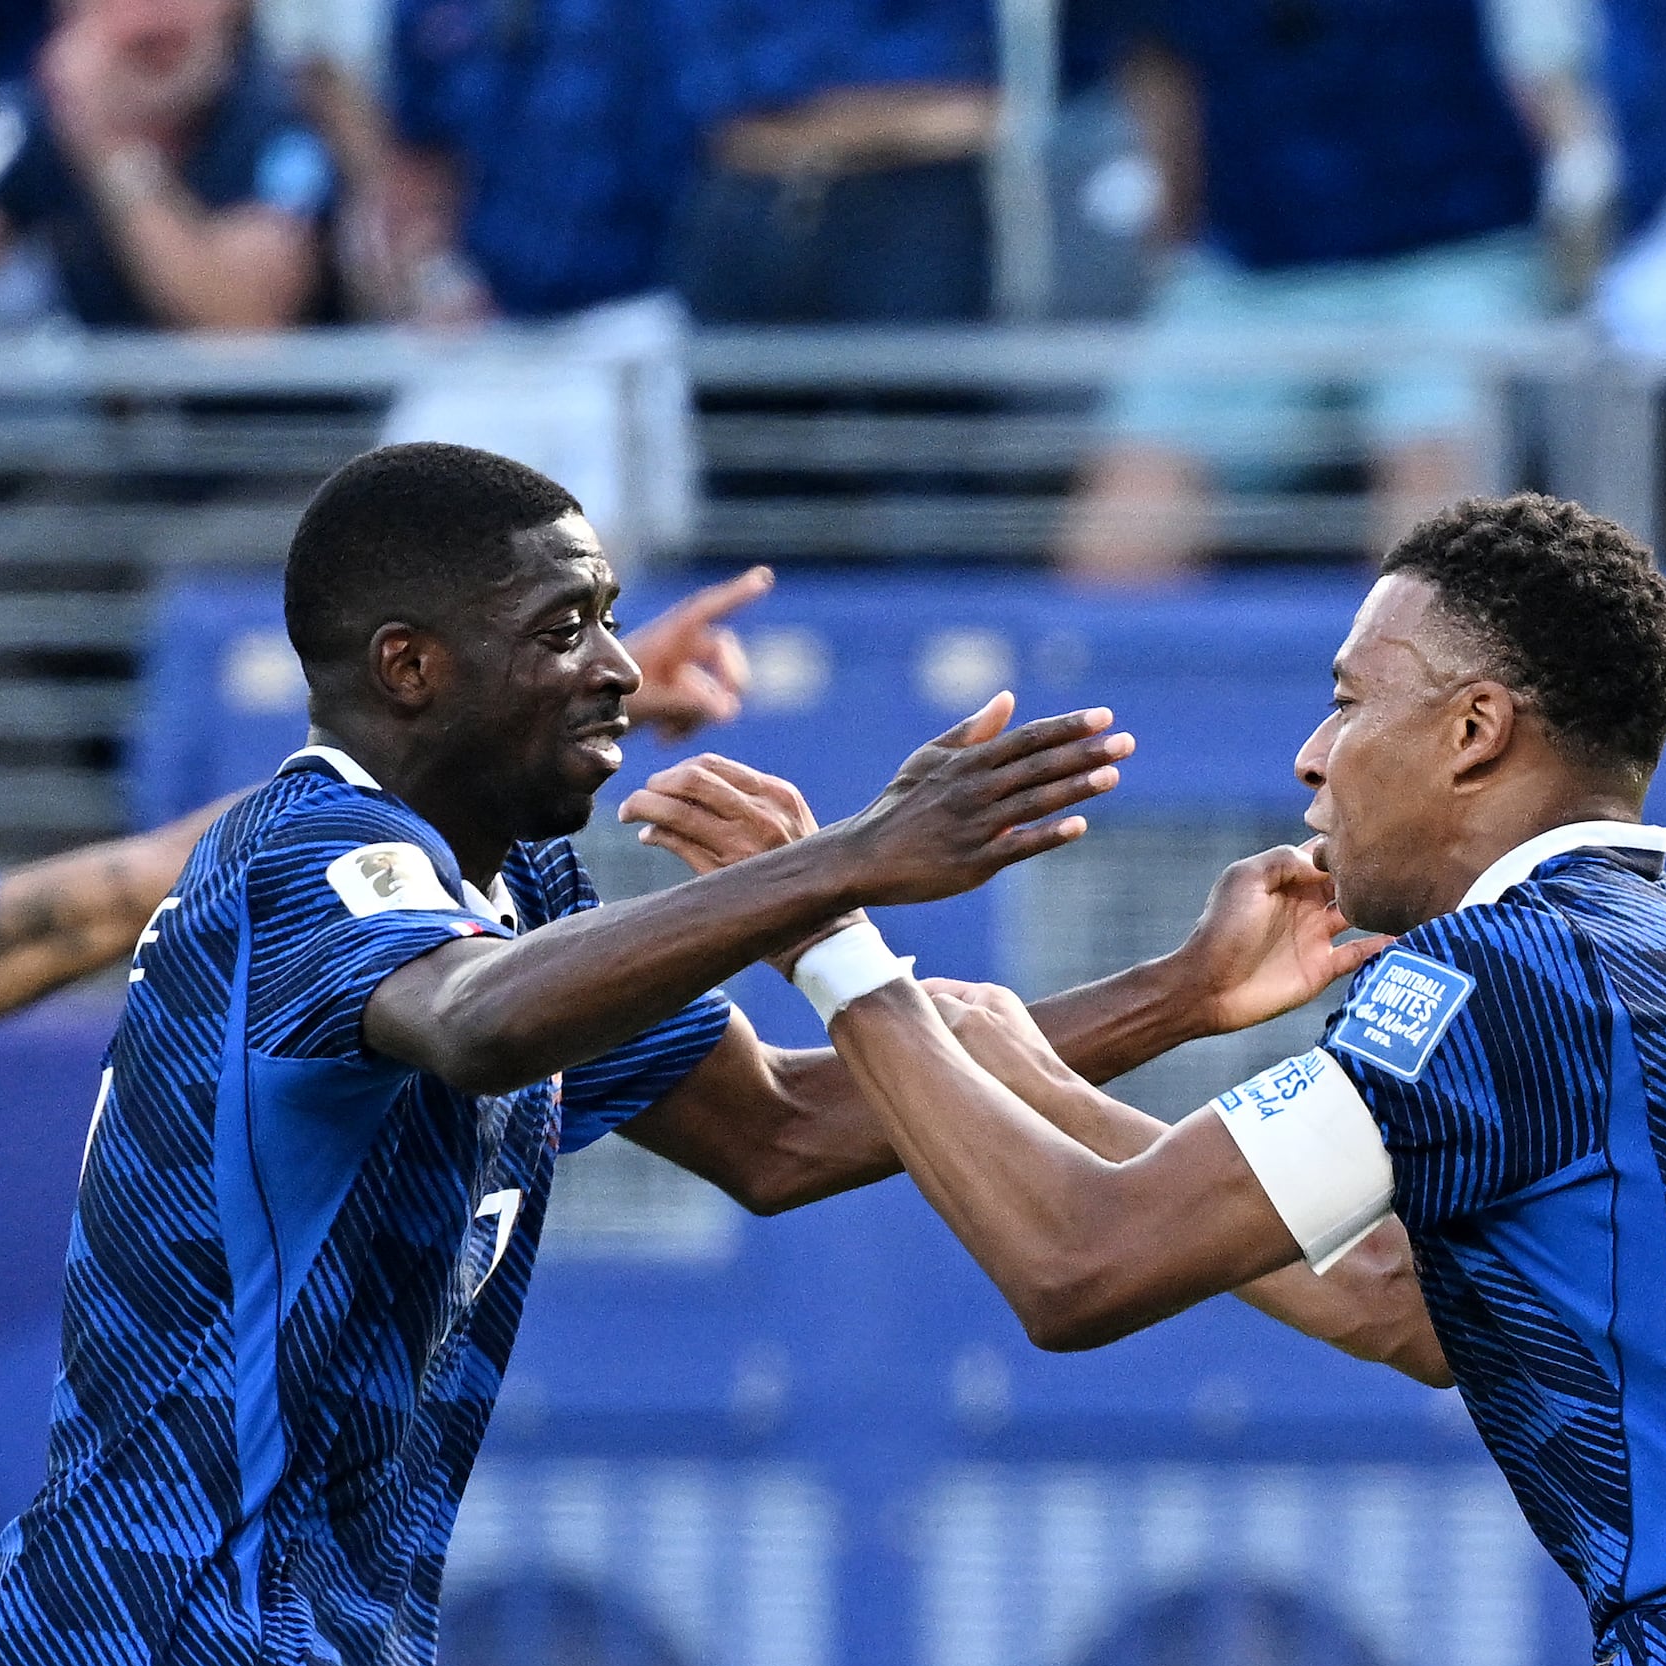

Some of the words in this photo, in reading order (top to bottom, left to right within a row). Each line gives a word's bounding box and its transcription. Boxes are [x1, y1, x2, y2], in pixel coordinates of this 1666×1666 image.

[1371, 980, 1438, 1023] UNITES
[1383, 965, 1447, 1002] FOOTBALL
[1355, 1002, 1379, 1023] the
[1376, 1009, 1430, 1047] World
[1363, 1026, 1393, 1049] FIFA
[1268, 1060, 1308, 1100] TES
[470, 1188, 523, 1300] 7
